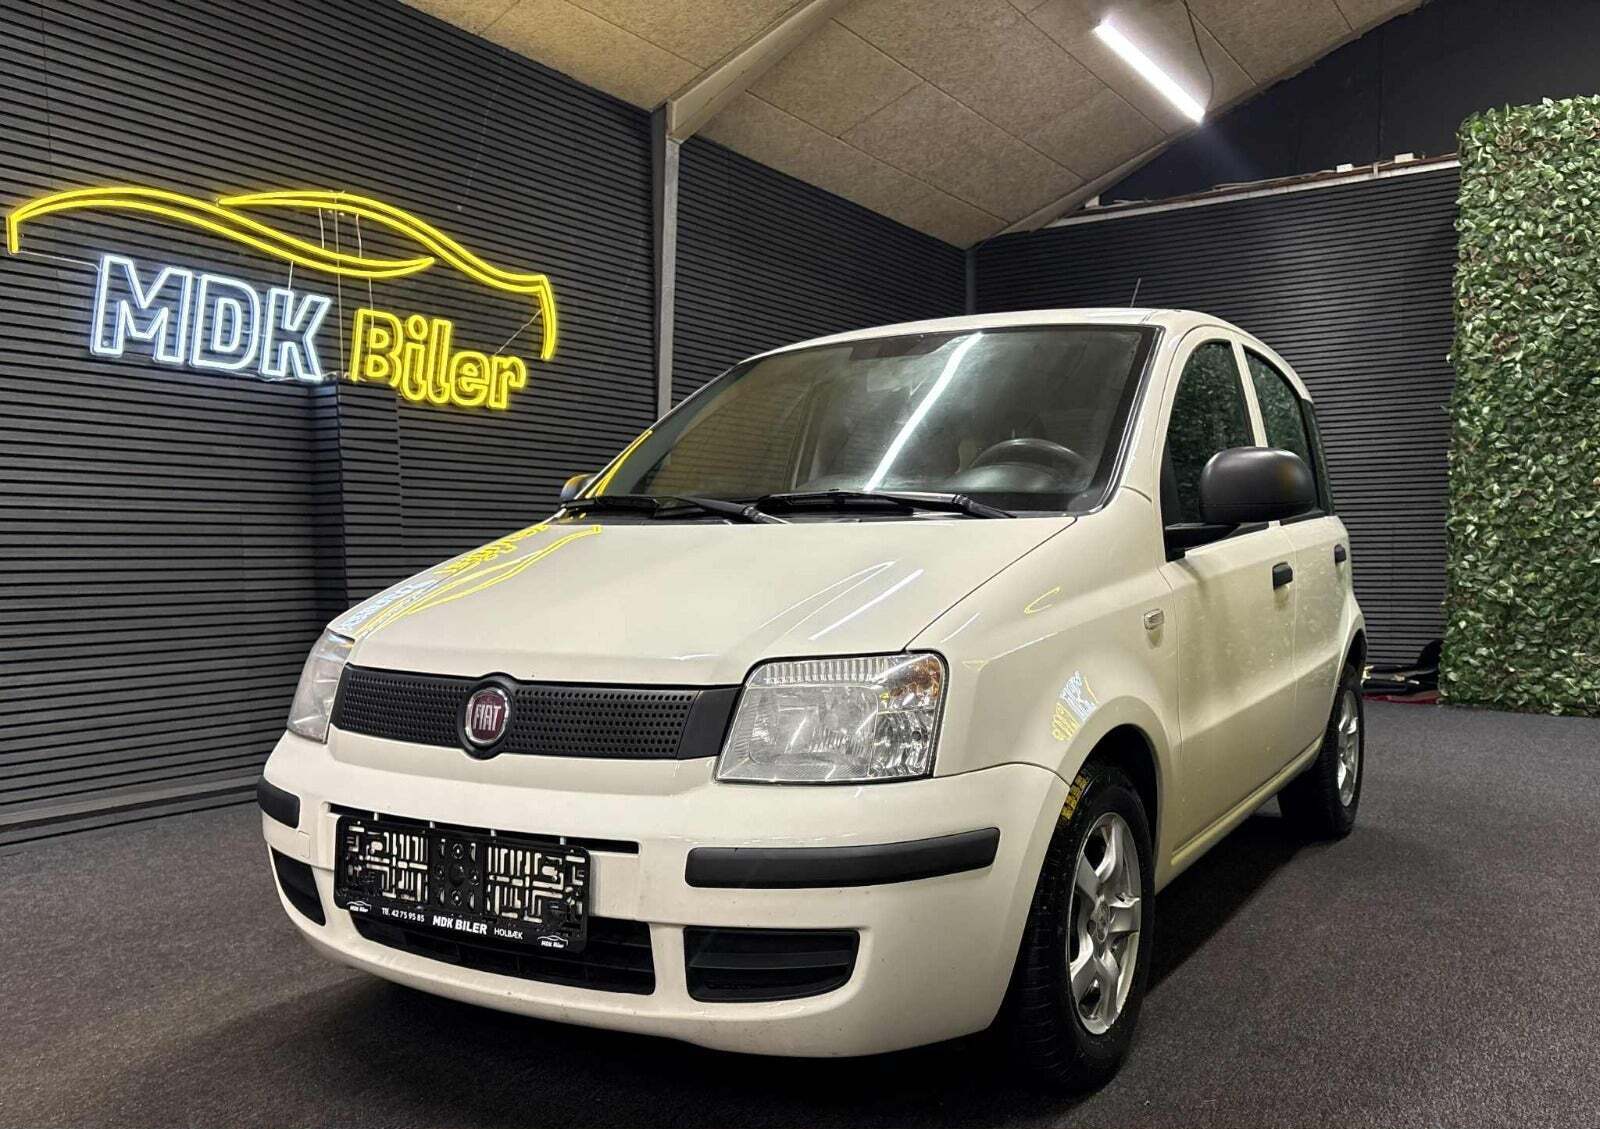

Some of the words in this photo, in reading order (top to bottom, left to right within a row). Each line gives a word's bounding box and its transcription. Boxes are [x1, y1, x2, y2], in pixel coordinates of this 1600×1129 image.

[90, 254, 331, 382] MDK
[350, 307, 527, 410] Biler
[472, 703, 502, 731] FIAT
[391, 909, 399, 918] 42
[432, 915, 454, 929] MDK
[455, 919, 488, 935] BILER
